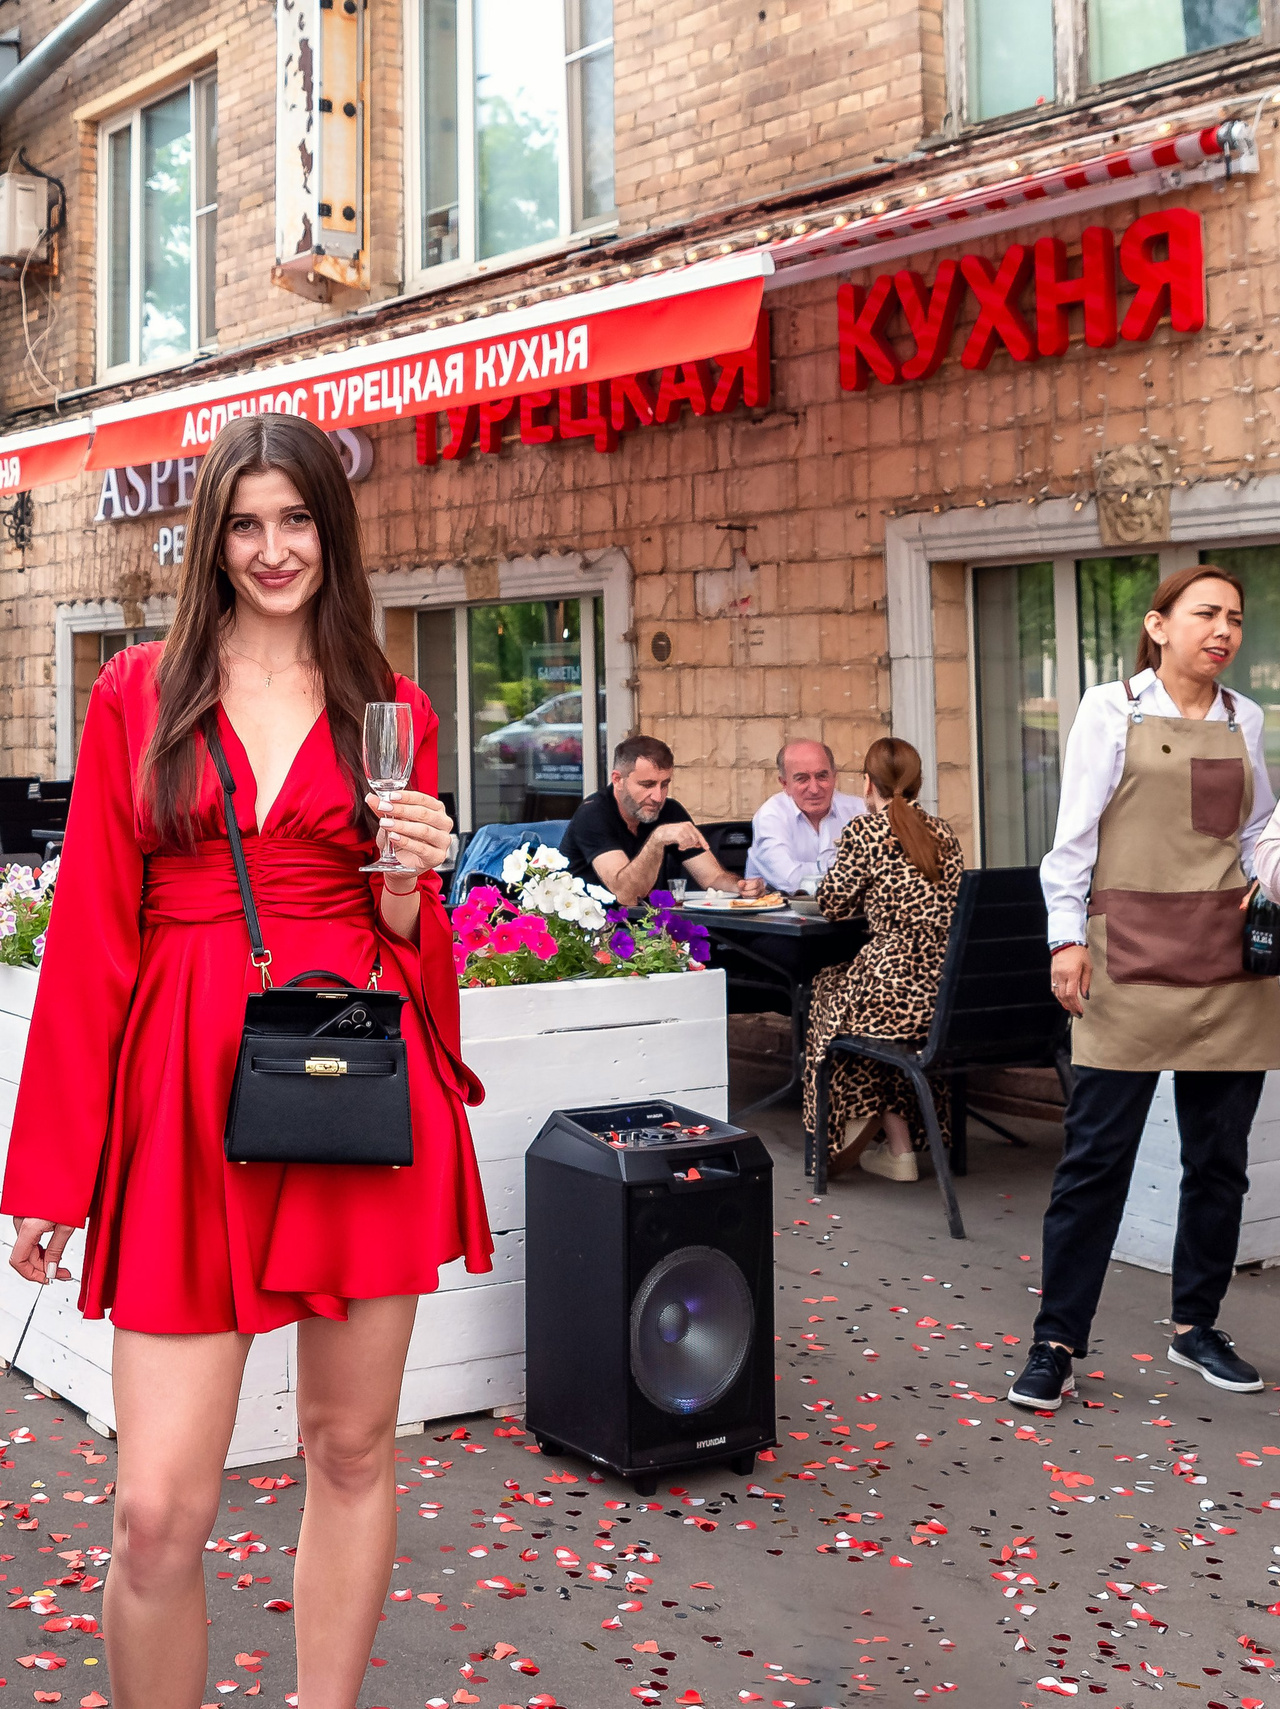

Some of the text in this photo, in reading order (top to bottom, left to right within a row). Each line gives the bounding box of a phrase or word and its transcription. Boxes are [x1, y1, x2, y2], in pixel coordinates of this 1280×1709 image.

[837, 208, 1205, 391] КУХНЯ
[313, 352, 464, 421] ТУРЕЦКАЯ
[475, 324, 588, 391] КУХНЯ
[696, 1436, 726, 1449] HYUNDAI
